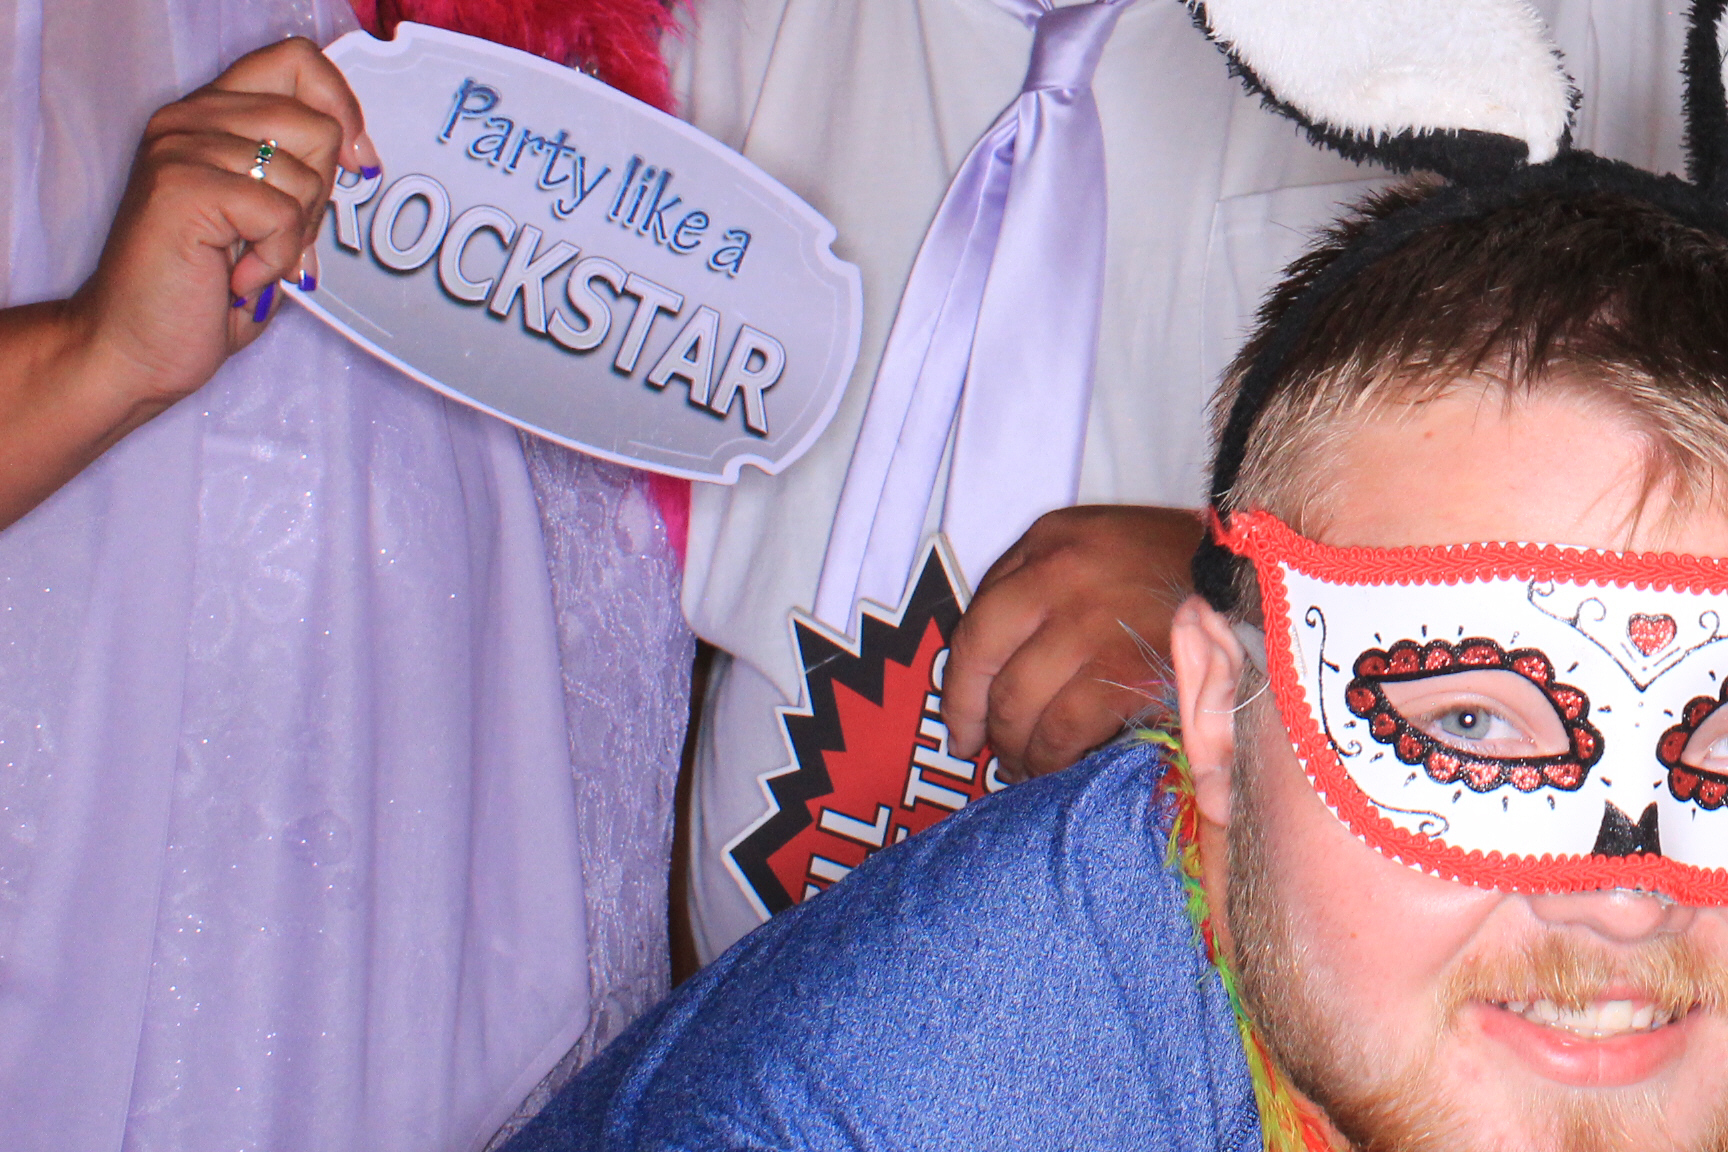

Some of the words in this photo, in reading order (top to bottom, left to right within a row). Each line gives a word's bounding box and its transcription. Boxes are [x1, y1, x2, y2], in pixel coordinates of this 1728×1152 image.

[439, 76, 608, 220] Party
[609, 153, 711, 255] like
[708, 227, 752, 277] a
[328, 164, 787, 436] ROCKSTAR
